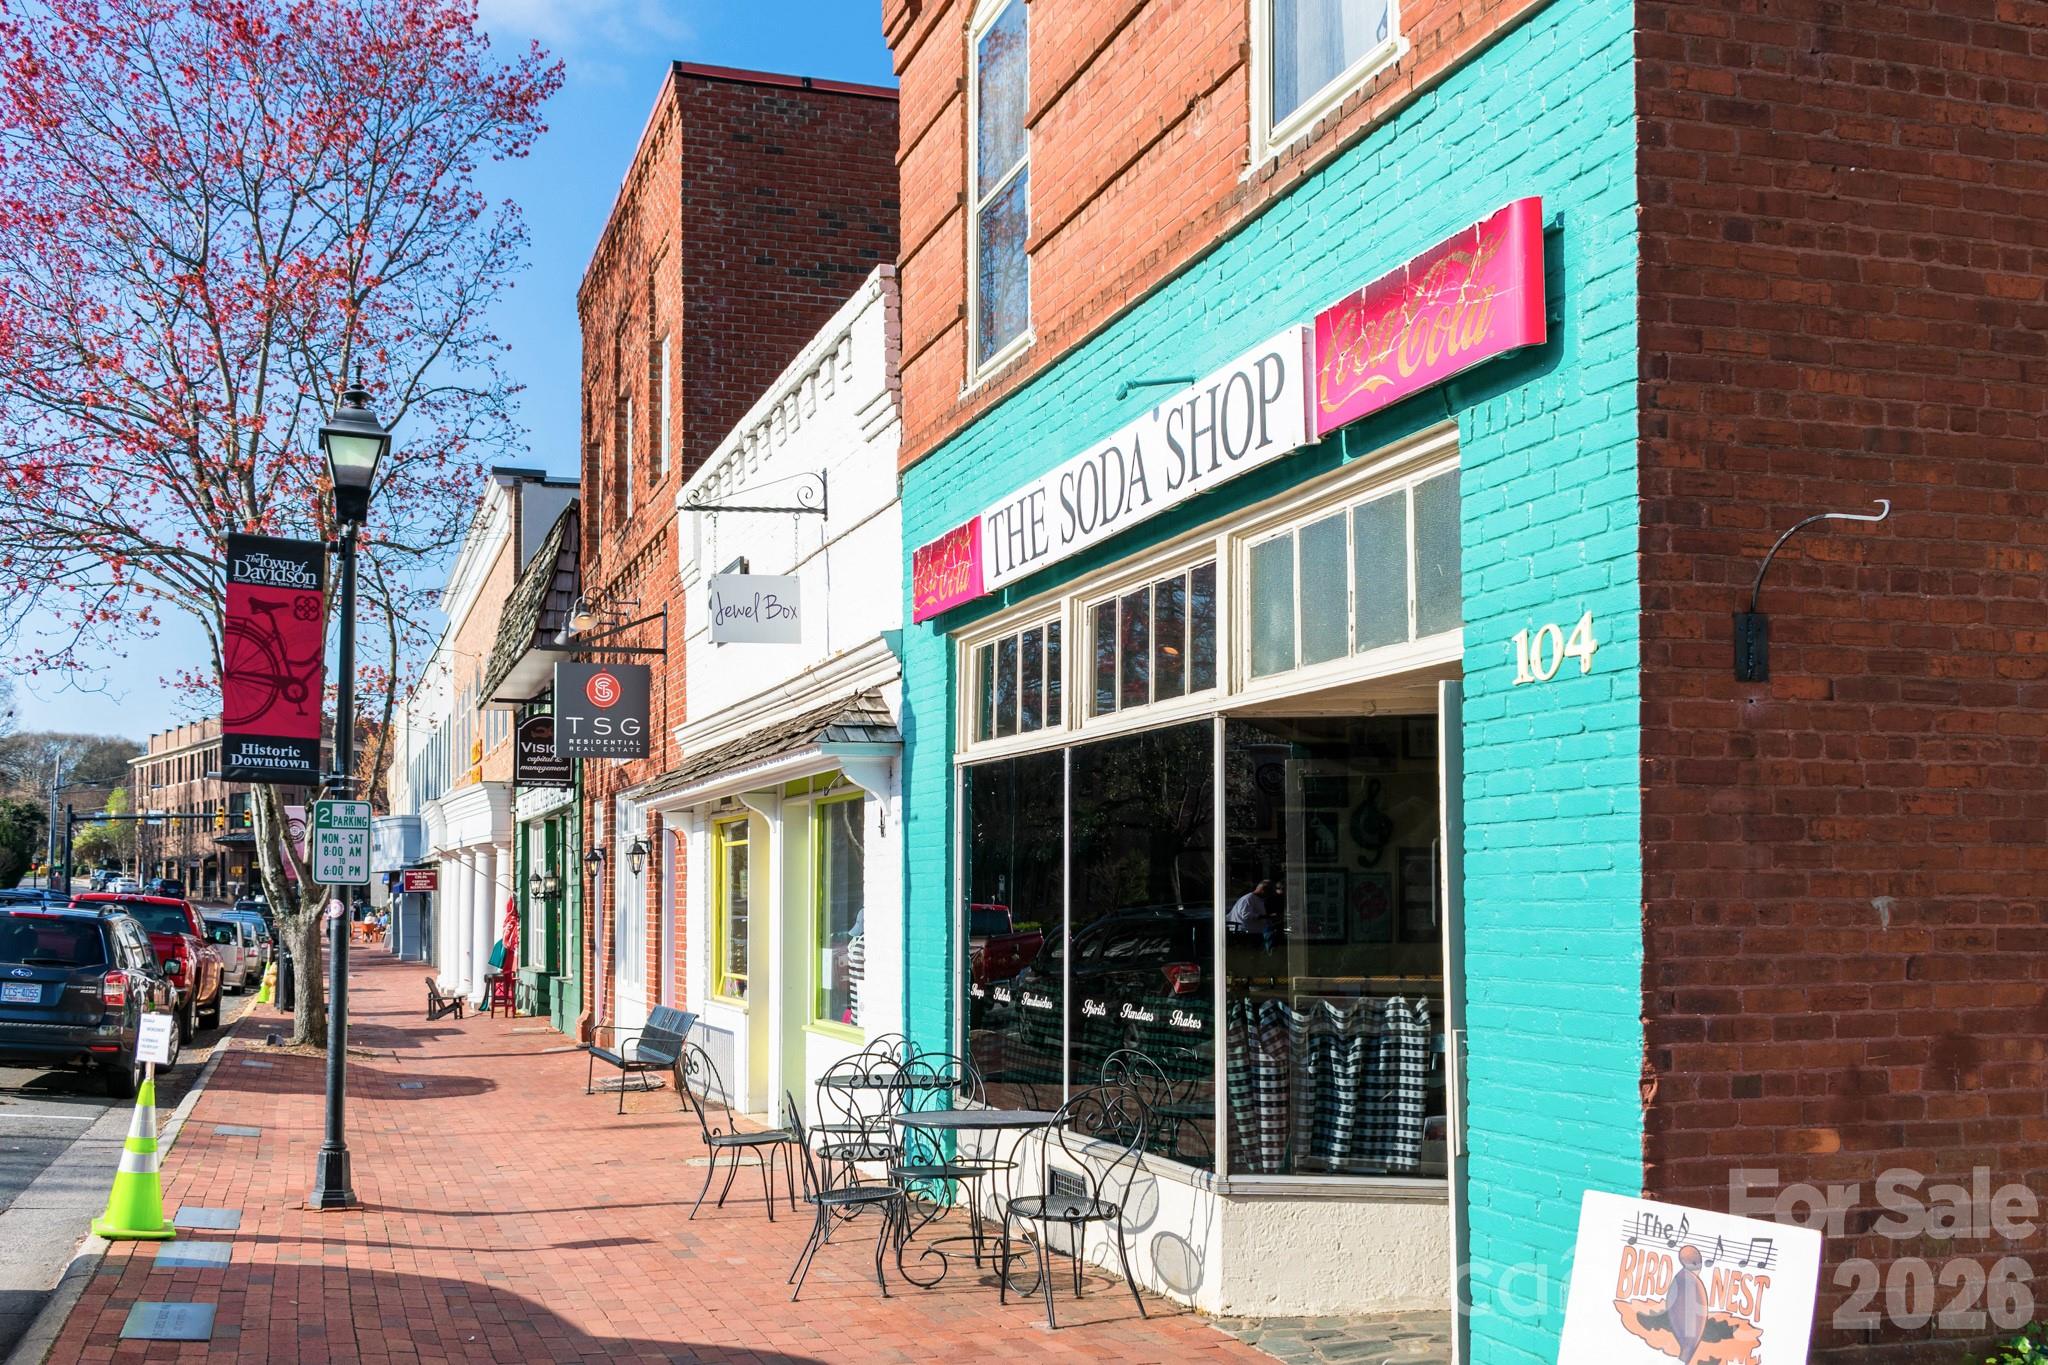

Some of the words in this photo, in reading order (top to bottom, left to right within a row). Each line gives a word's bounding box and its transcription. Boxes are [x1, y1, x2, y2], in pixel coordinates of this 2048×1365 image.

[987, 486, 1050, 578] THE
[1059, 431, 1153, 545] SODA
[1166, 352, 1285, 493] SHOP
[245, 554, 259, 564] The
[256, 552, 294, 570] Town
[293, 561, 309, 573] of
[232, 559, 318, 585] Davidson
[715, 591, 760, 626] Jewel
[763, 594, 798, 620] Box
[1511, 609, 1599, 686] 104
[565, 716, 641, 736] TSG
[240, 743, 301, 757] Historic
[568, 738, 641, 746] RESIDENTIAL
[230, 753, 310, 769] Downtown
[519, 765, 568, 774] management
[319, 807, 330, 823] 2
[345, 805, 356, 815] HR
[333, 815, 367, 827] PARKING
[321, 833, 339, 844] MON
[348, 833, 364, 845] SAT
[323, 846, 343, 857] 8:00
[348, 847, 362, 857] AM
[339, 857, 346, 865] TO
[323, 865, 344, 876] 6:00
[348, 866, 361, 877] PM
[1021, 992, 1053, 1009] Sandwiches
[1082, 999, 1107, 1018] Spirits
[1120, 1003, 1154, 1022] Sundaes
[1169, 1009, 1202, 1029] Shakes
[1643, 1213, 1674, 1240] The
[1616, 1245, 1674, 1299] BIRD
[1709, 1267, 1771, 1322] NEST
